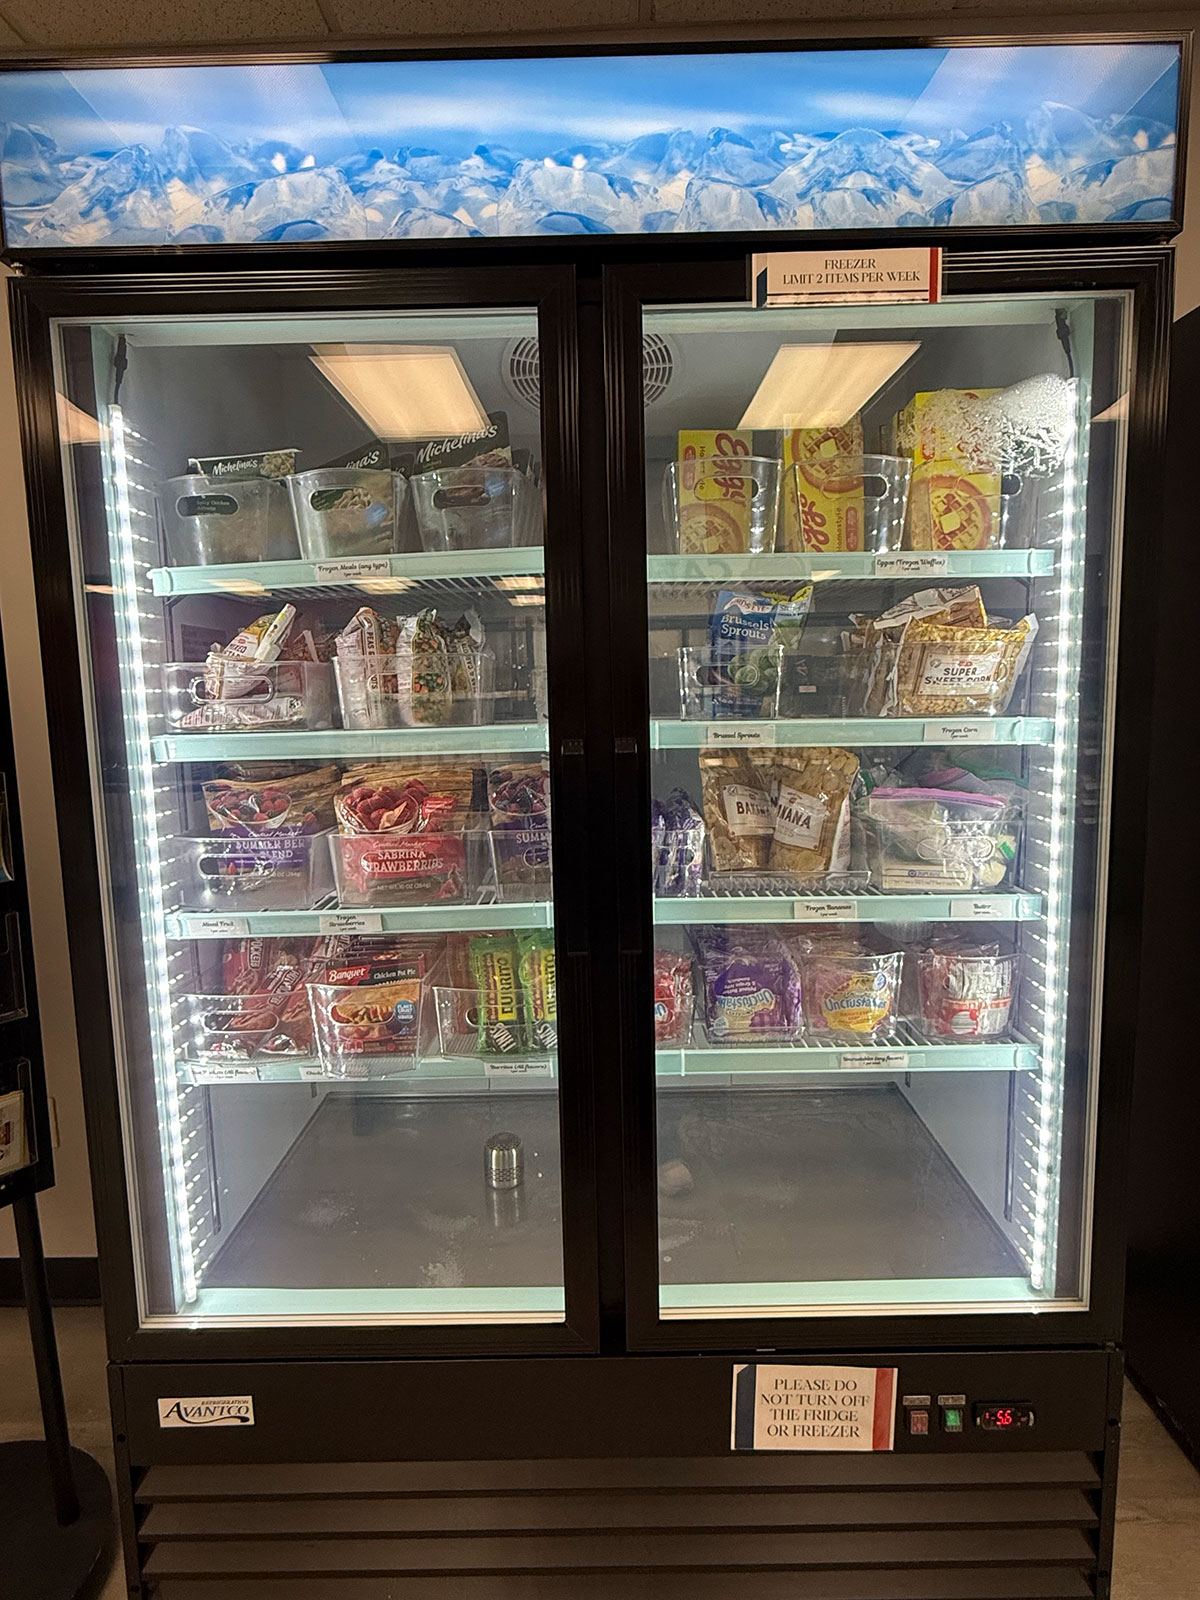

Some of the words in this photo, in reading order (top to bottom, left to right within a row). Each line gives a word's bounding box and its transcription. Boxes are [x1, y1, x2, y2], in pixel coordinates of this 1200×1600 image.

[824, 258, 876, 270] FREEZER
[783, 273, 815, 285] LIMIT
[816, 273, 823, 284] 2
[825, 272, 860, 284] ITEMS
[861, 272, 885, 283] PER
[887, 270, 921, 282] WEEK
[212, 458, 258, 476] Michelina's
[318, 565, 339, 574] Frozen
[720, 613, 770, 631] Brussels
[721, 623, 766, 640] Sprouts
[366, 631, 376, 649] PEAS
[943, 667, 978, 676] SUPER
[941, 727, 962, 735] Frozen
[377, 849, 426, 861] SABRINA
[805, 905, 826, 913] Frozen
[328, 967, 367, 983] Banquet
[373, 970, 397, 979] Chicken
[407, 968, 416, 976] Pie
[774, 1378, 830, 1391] PLEASE
[834, 1379, 858, 1391] DO
[761, 1394, 795, 1406] NOT
[798, 1394, 839, 1407] TURN
[844, 1395, 871, 1408] OFF
[163, 1401, 250, 1422] AVANTCO
[769, 1409, 800, 1421] THE
[803, 1409, 859, 1422] FRIDGE
[767, 1424, 790, 1437] OR
[793, 1424, 861, 1438] FREEZER
